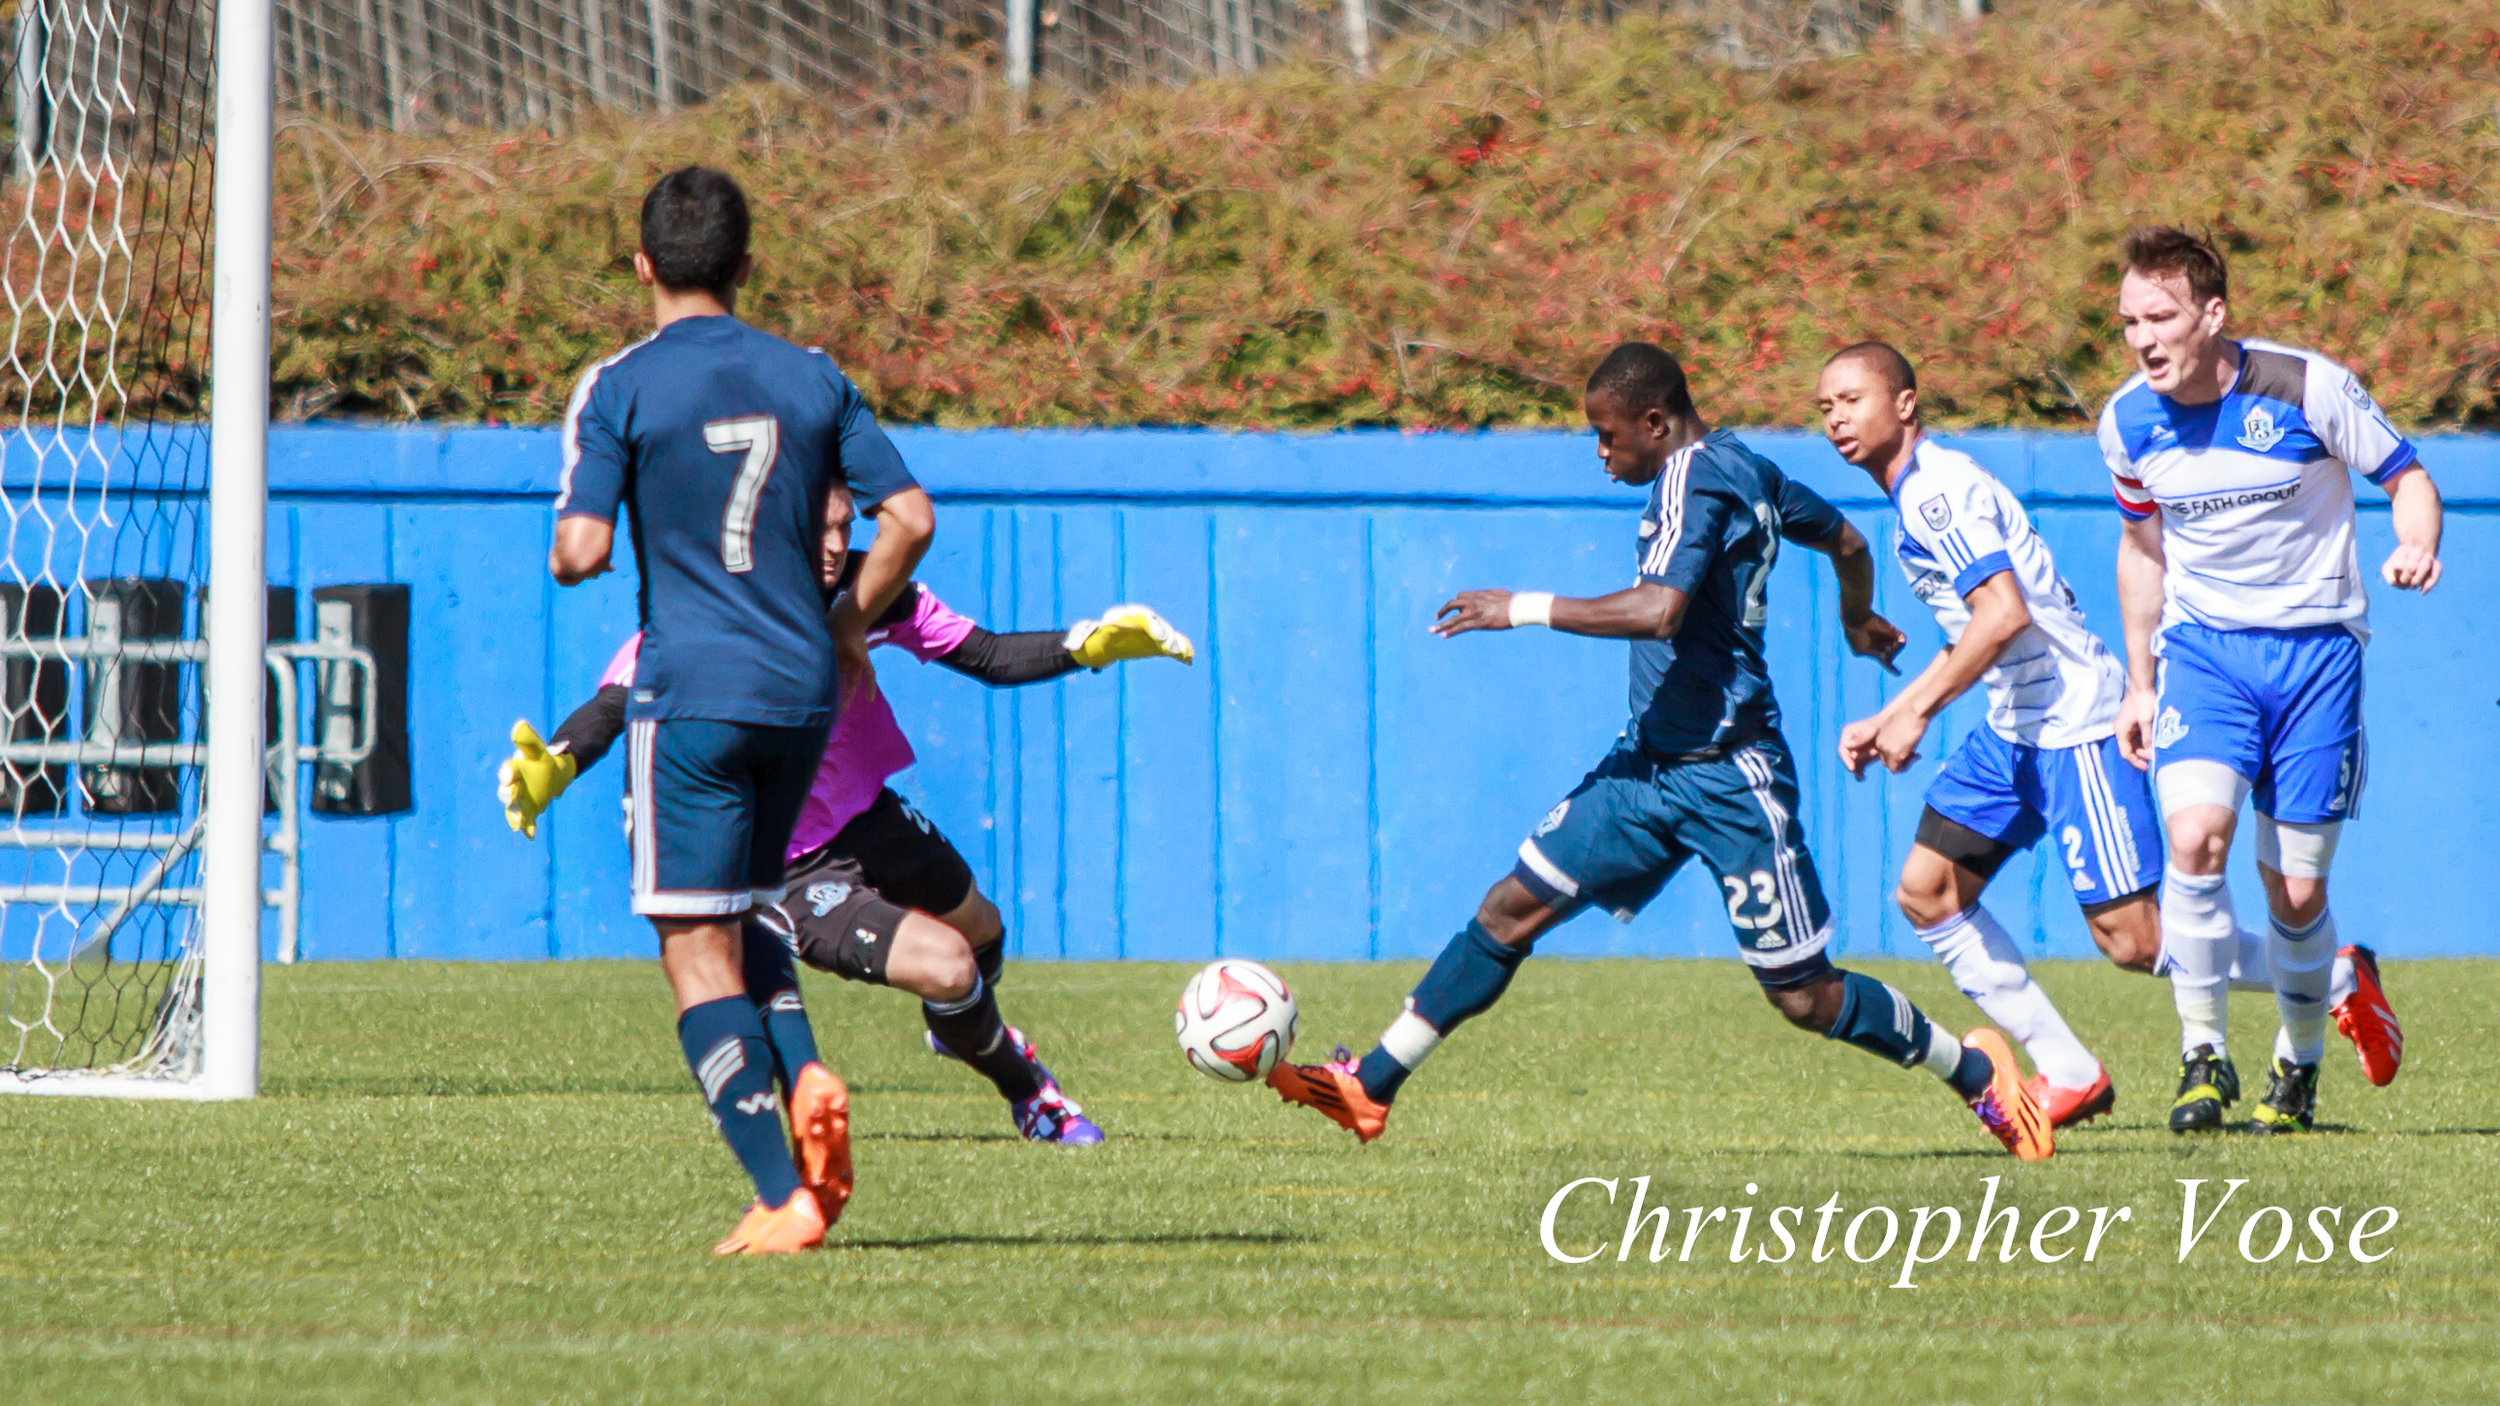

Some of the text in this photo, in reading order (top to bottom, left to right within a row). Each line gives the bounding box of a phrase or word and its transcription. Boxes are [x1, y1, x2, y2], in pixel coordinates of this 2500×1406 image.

[703, 414, 778, 573] 7
[2192, 496, 2234, 516] FATH
[2237, 483, 2301, 506] GROUP
[2062, 825, 2086, 869] 2
[1723, 870, 1783, 929] 23
